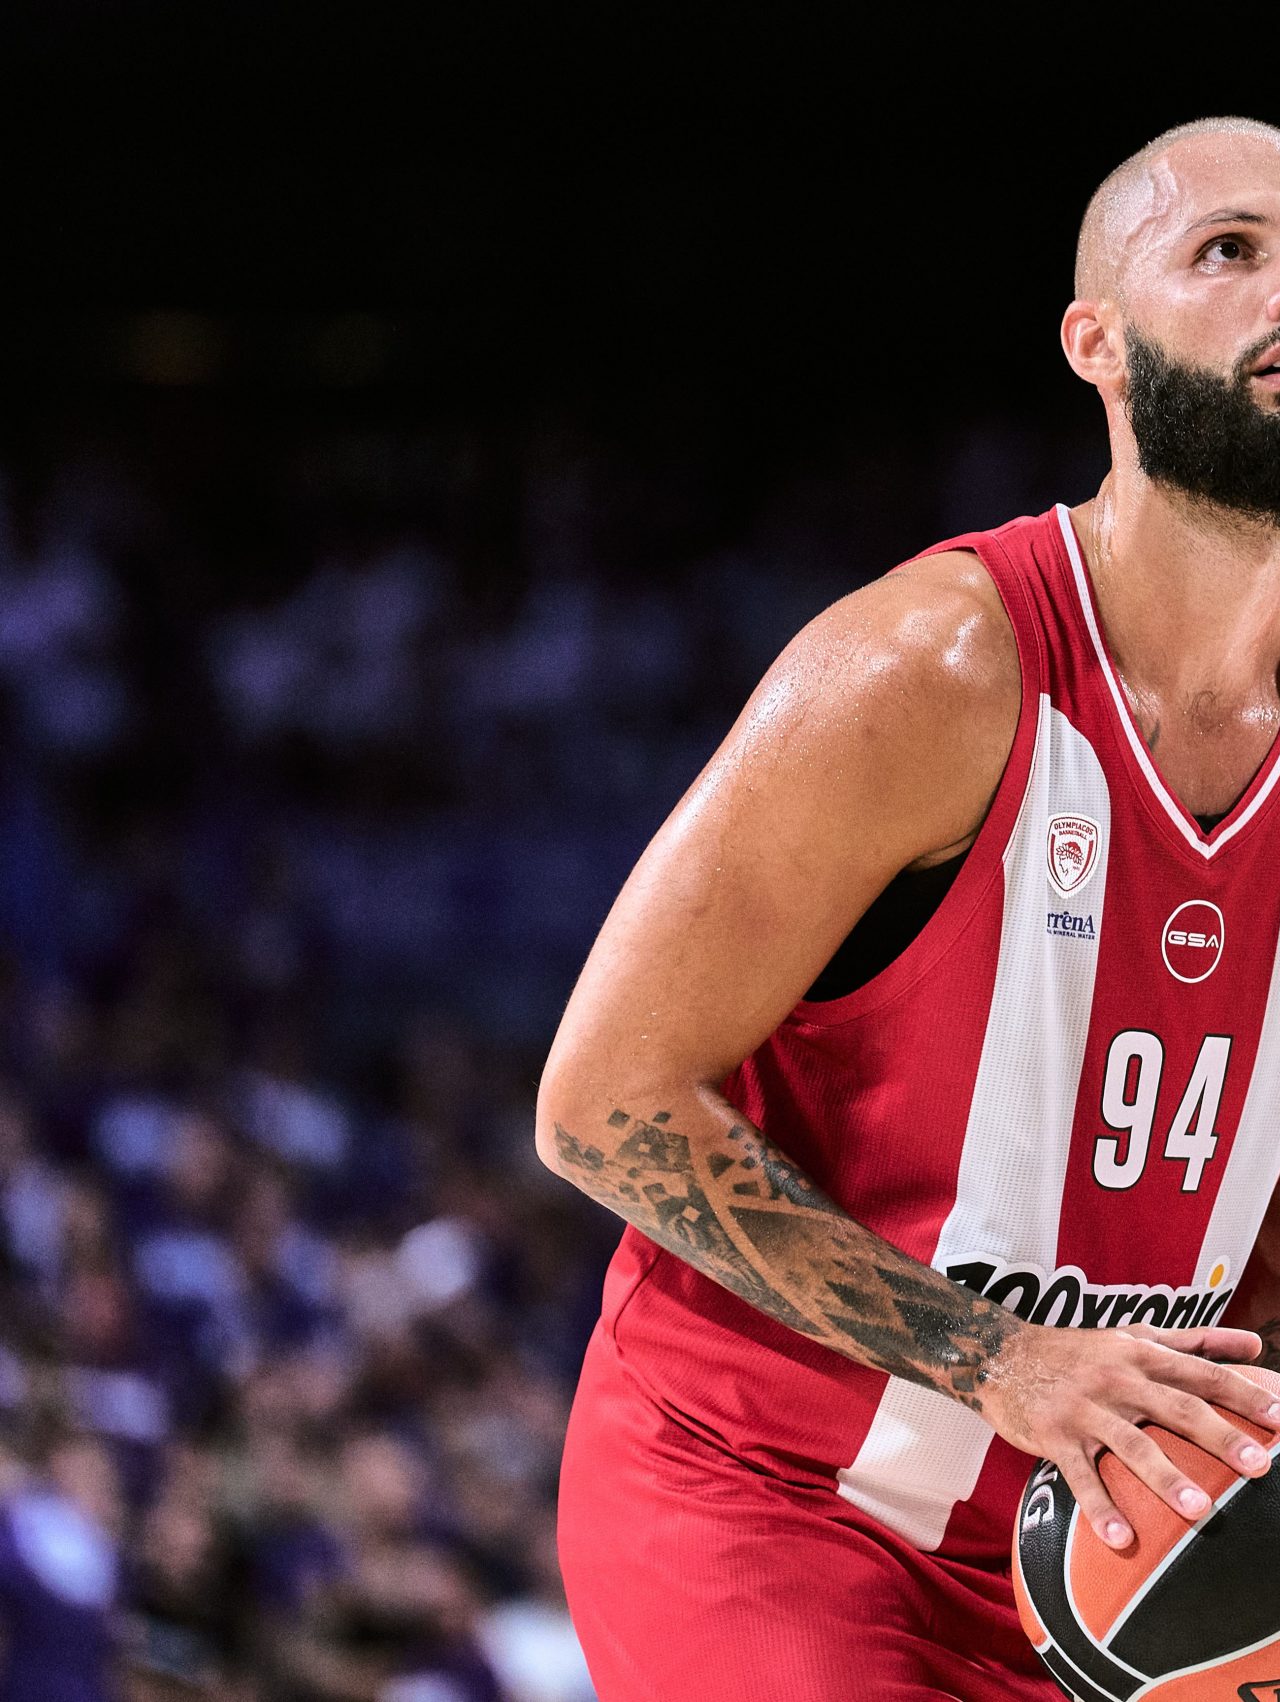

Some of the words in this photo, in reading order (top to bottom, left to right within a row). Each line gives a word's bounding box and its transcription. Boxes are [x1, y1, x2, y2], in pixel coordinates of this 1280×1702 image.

[1054, 822, 1094, 835] OLYMPIACOS
[1053, 930, 1077, 938] MINERAL
[1168, 930, 1219, 949] GSA
[1092, 1028, 1233, 1194] 94
